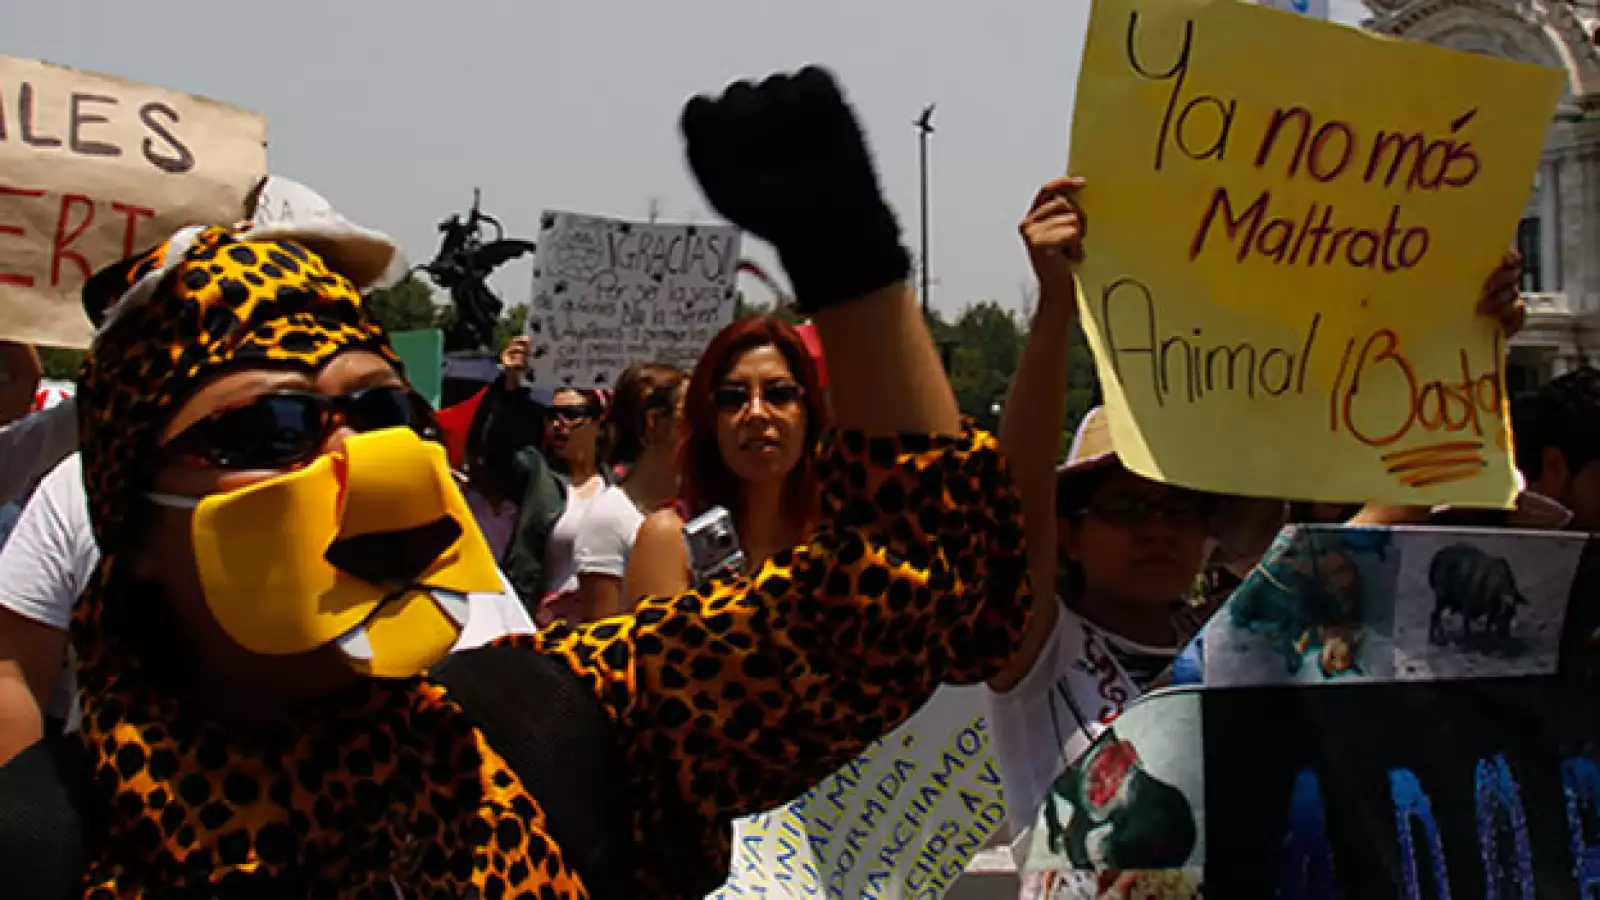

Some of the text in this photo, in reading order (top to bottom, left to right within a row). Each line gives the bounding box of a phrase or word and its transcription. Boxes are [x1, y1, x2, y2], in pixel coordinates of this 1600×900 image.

[0, 82, 195, 173] LES
[1127, 11, 1481, 192] Ya no más
[1189, 187, 1429, 272] Maltrato
[1101, 277, 1321, 406] Animal
